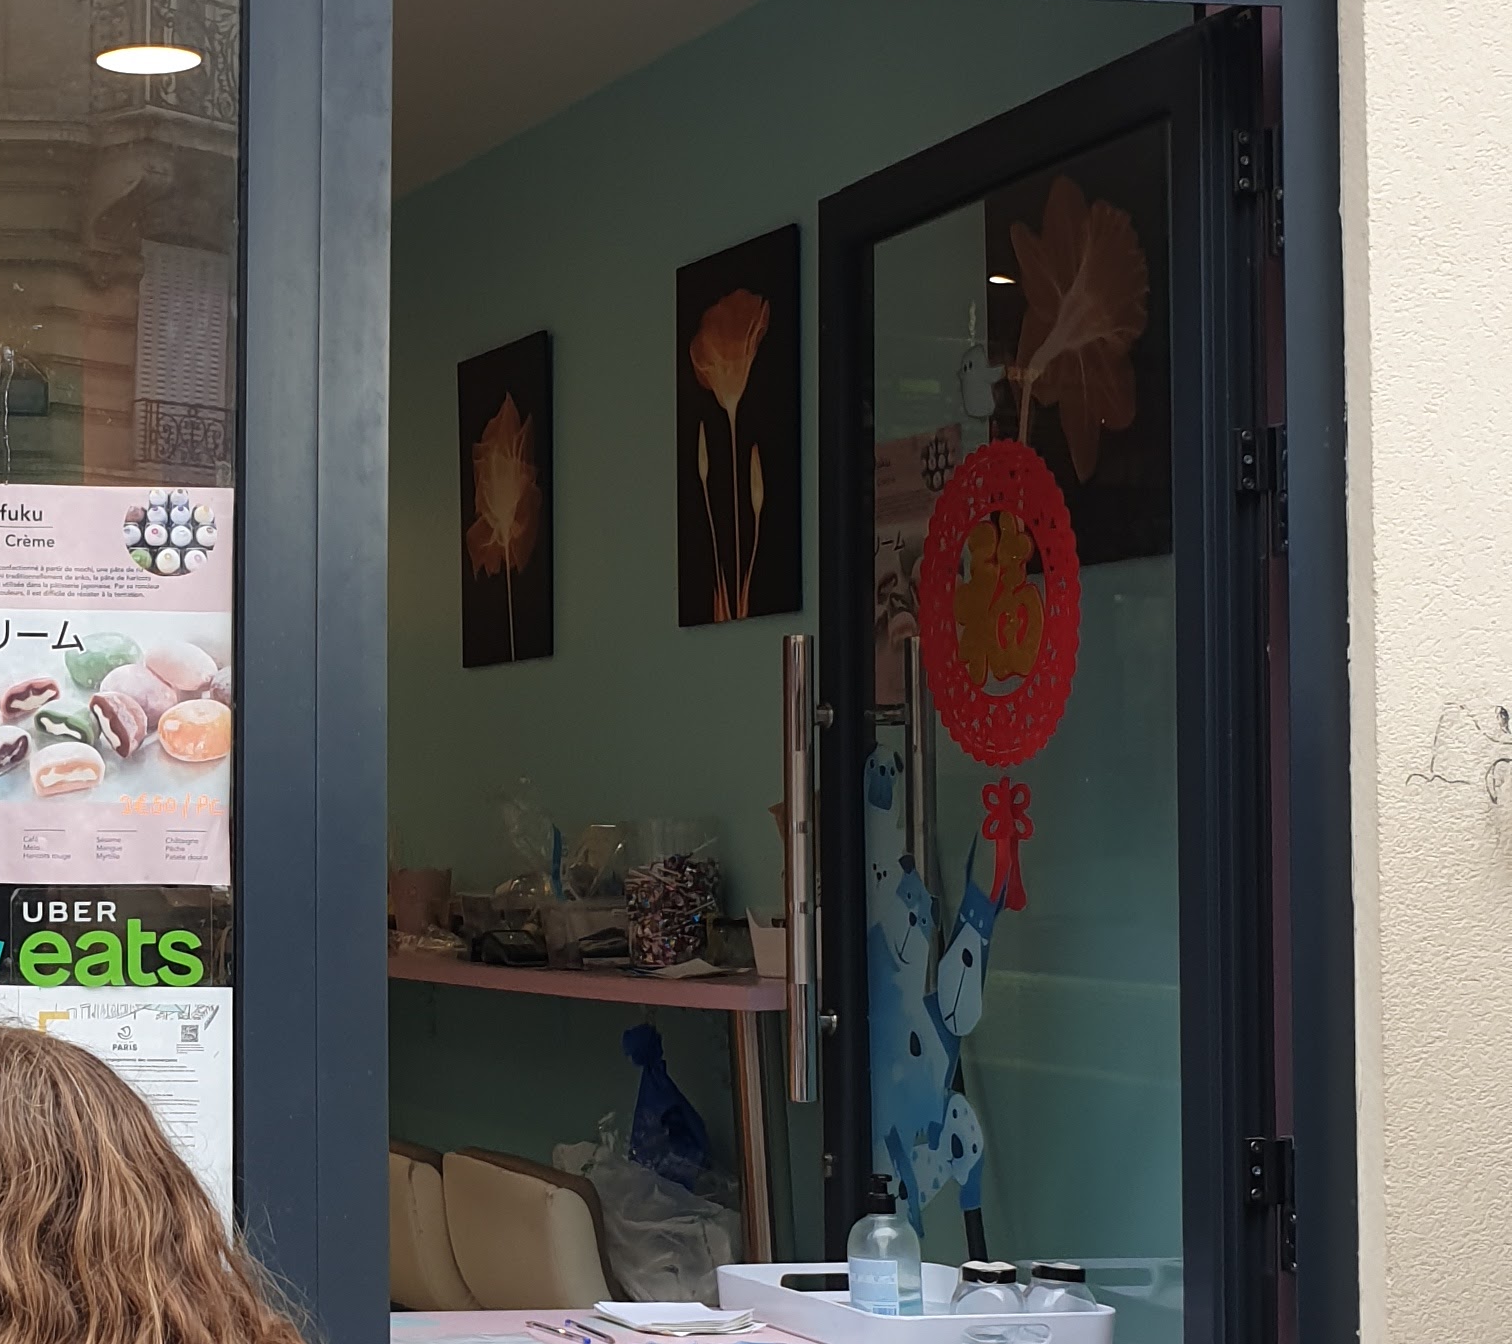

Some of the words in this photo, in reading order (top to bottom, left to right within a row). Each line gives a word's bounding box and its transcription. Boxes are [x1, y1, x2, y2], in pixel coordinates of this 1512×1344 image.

[5, 533, 55, 548] Crème
[22, 900, 117, 923] UBER
[19, 918, 205, 988] eats
[112, 1043, 138, 1051] PARIS
